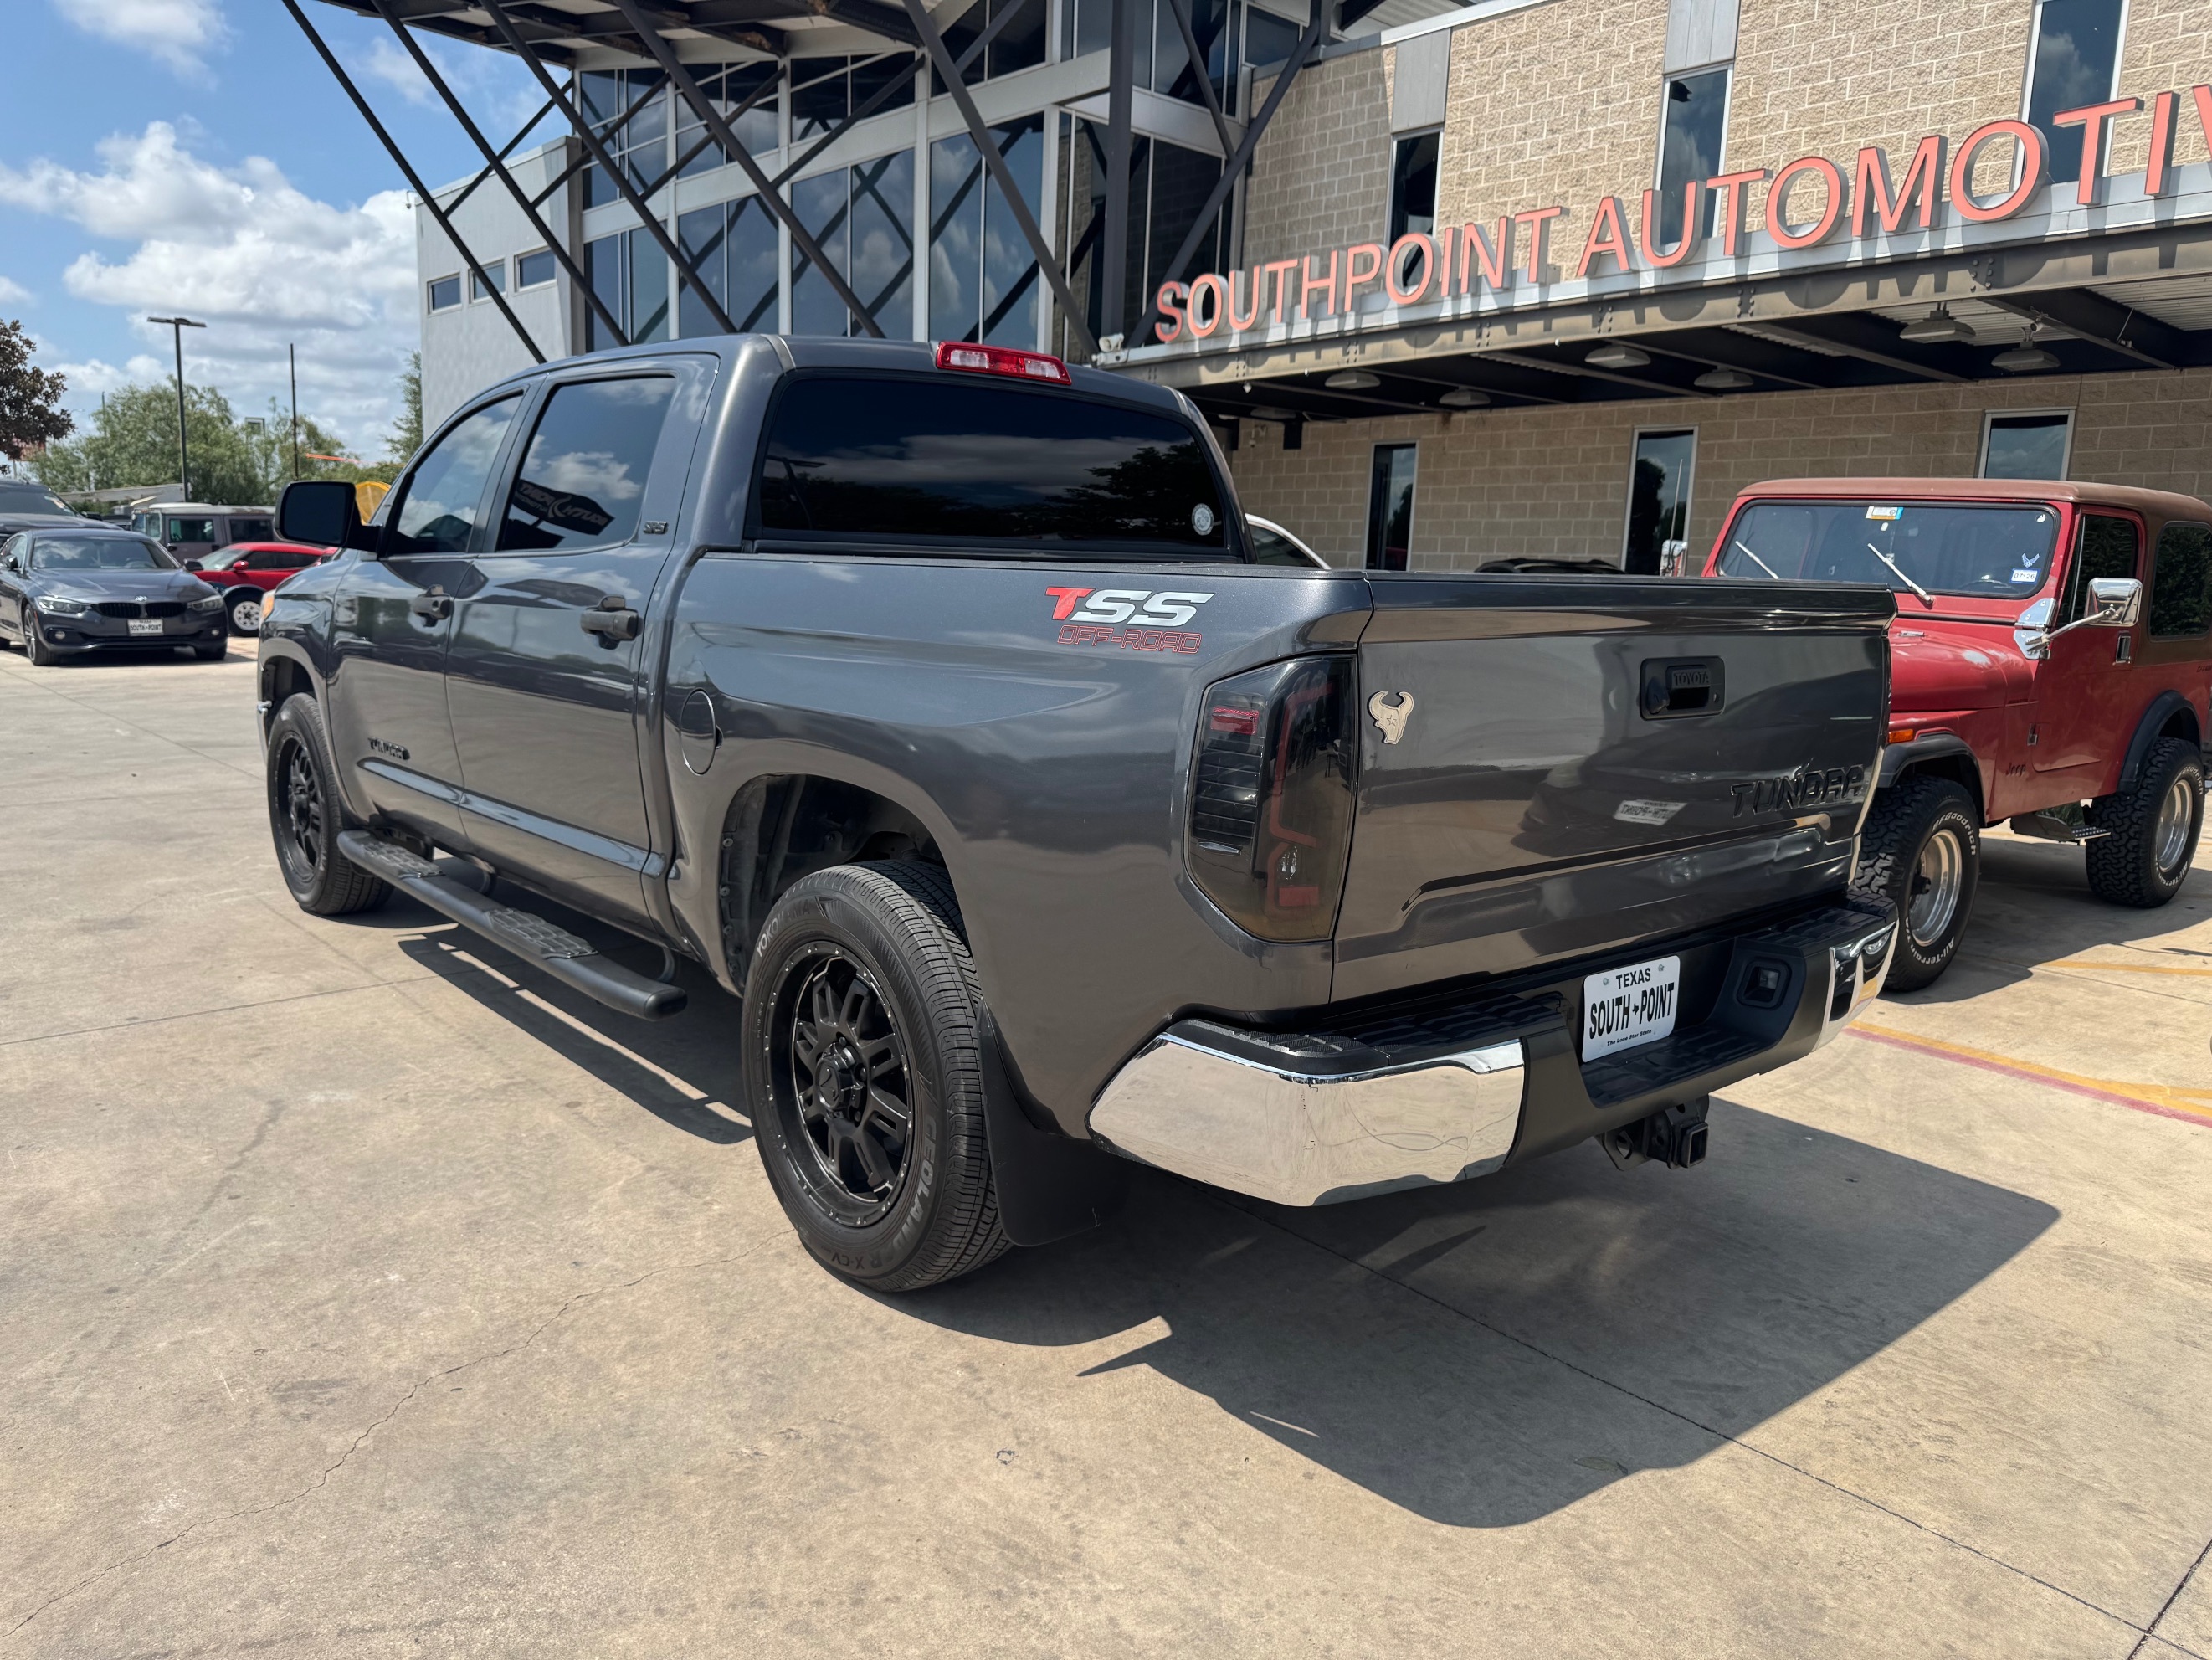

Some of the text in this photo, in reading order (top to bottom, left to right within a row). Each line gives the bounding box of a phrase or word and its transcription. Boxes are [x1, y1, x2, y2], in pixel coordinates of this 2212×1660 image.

[1154, 83, 2212, 342] SOUTHPOINT AUTOMOTI
[1045, 587, 1215, 627] TSS
[1057, 624, 1203, 654] OFF-ROAD
[1674, 671, 1710, 686] TOYOTA
[1730, 763, 1865, 819] TUNDRA
[1616, 968, 1651, 989] TEXAS
[1589, 982, 1675, 1039] SOUTH POINT
